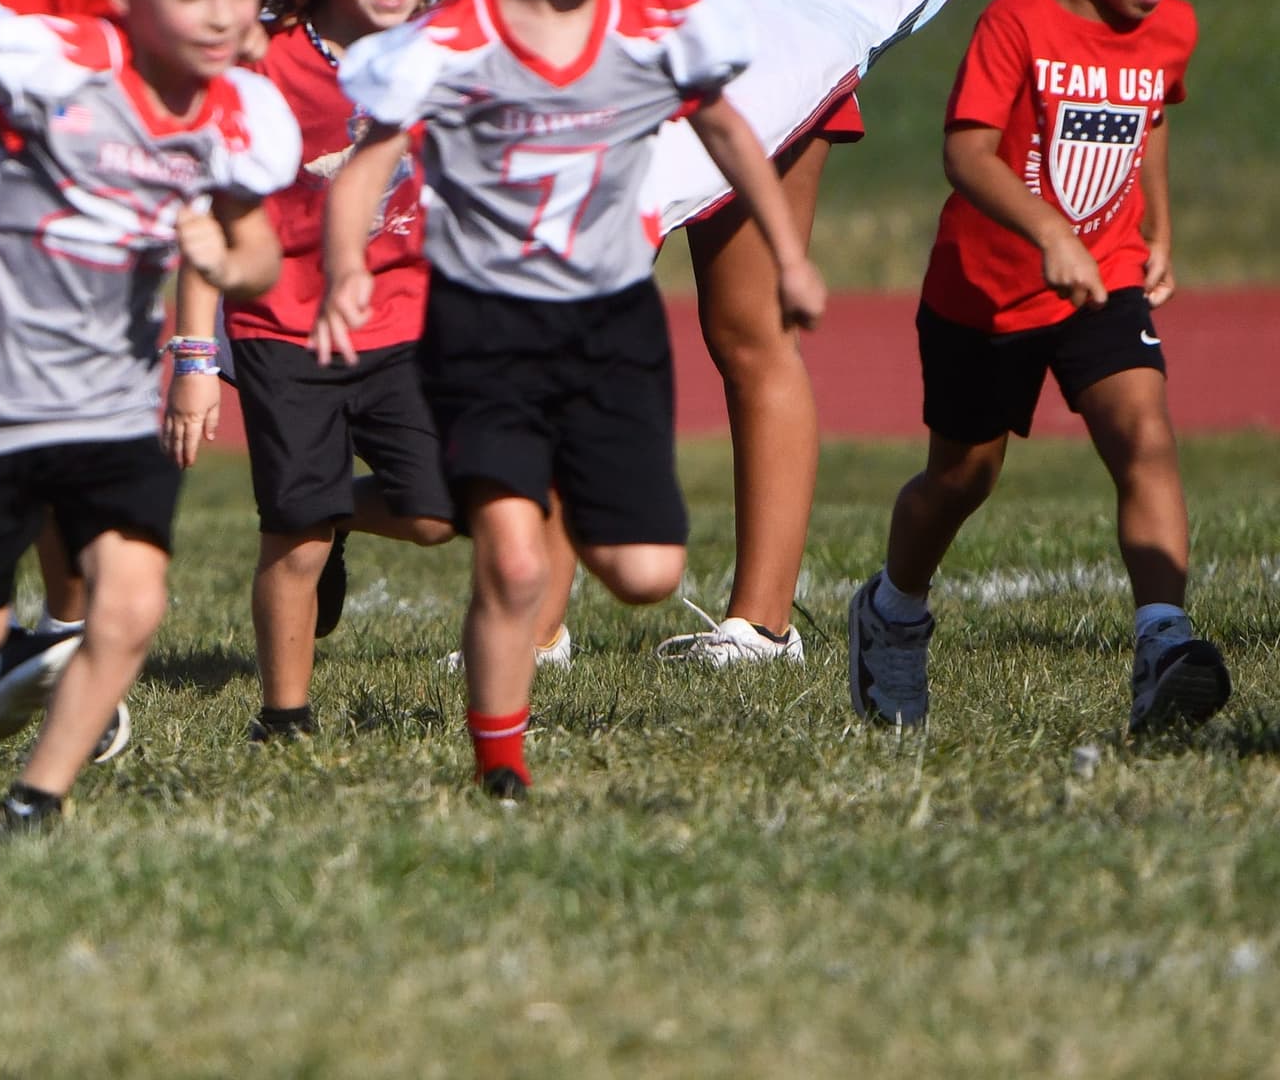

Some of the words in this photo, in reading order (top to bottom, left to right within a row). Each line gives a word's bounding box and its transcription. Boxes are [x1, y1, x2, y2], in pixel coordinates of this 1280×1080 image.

[1036, 58, 1108, 99] TEAM
[1119, 68, 1165, 102] USA
[502, 142, 608, 261] 7
